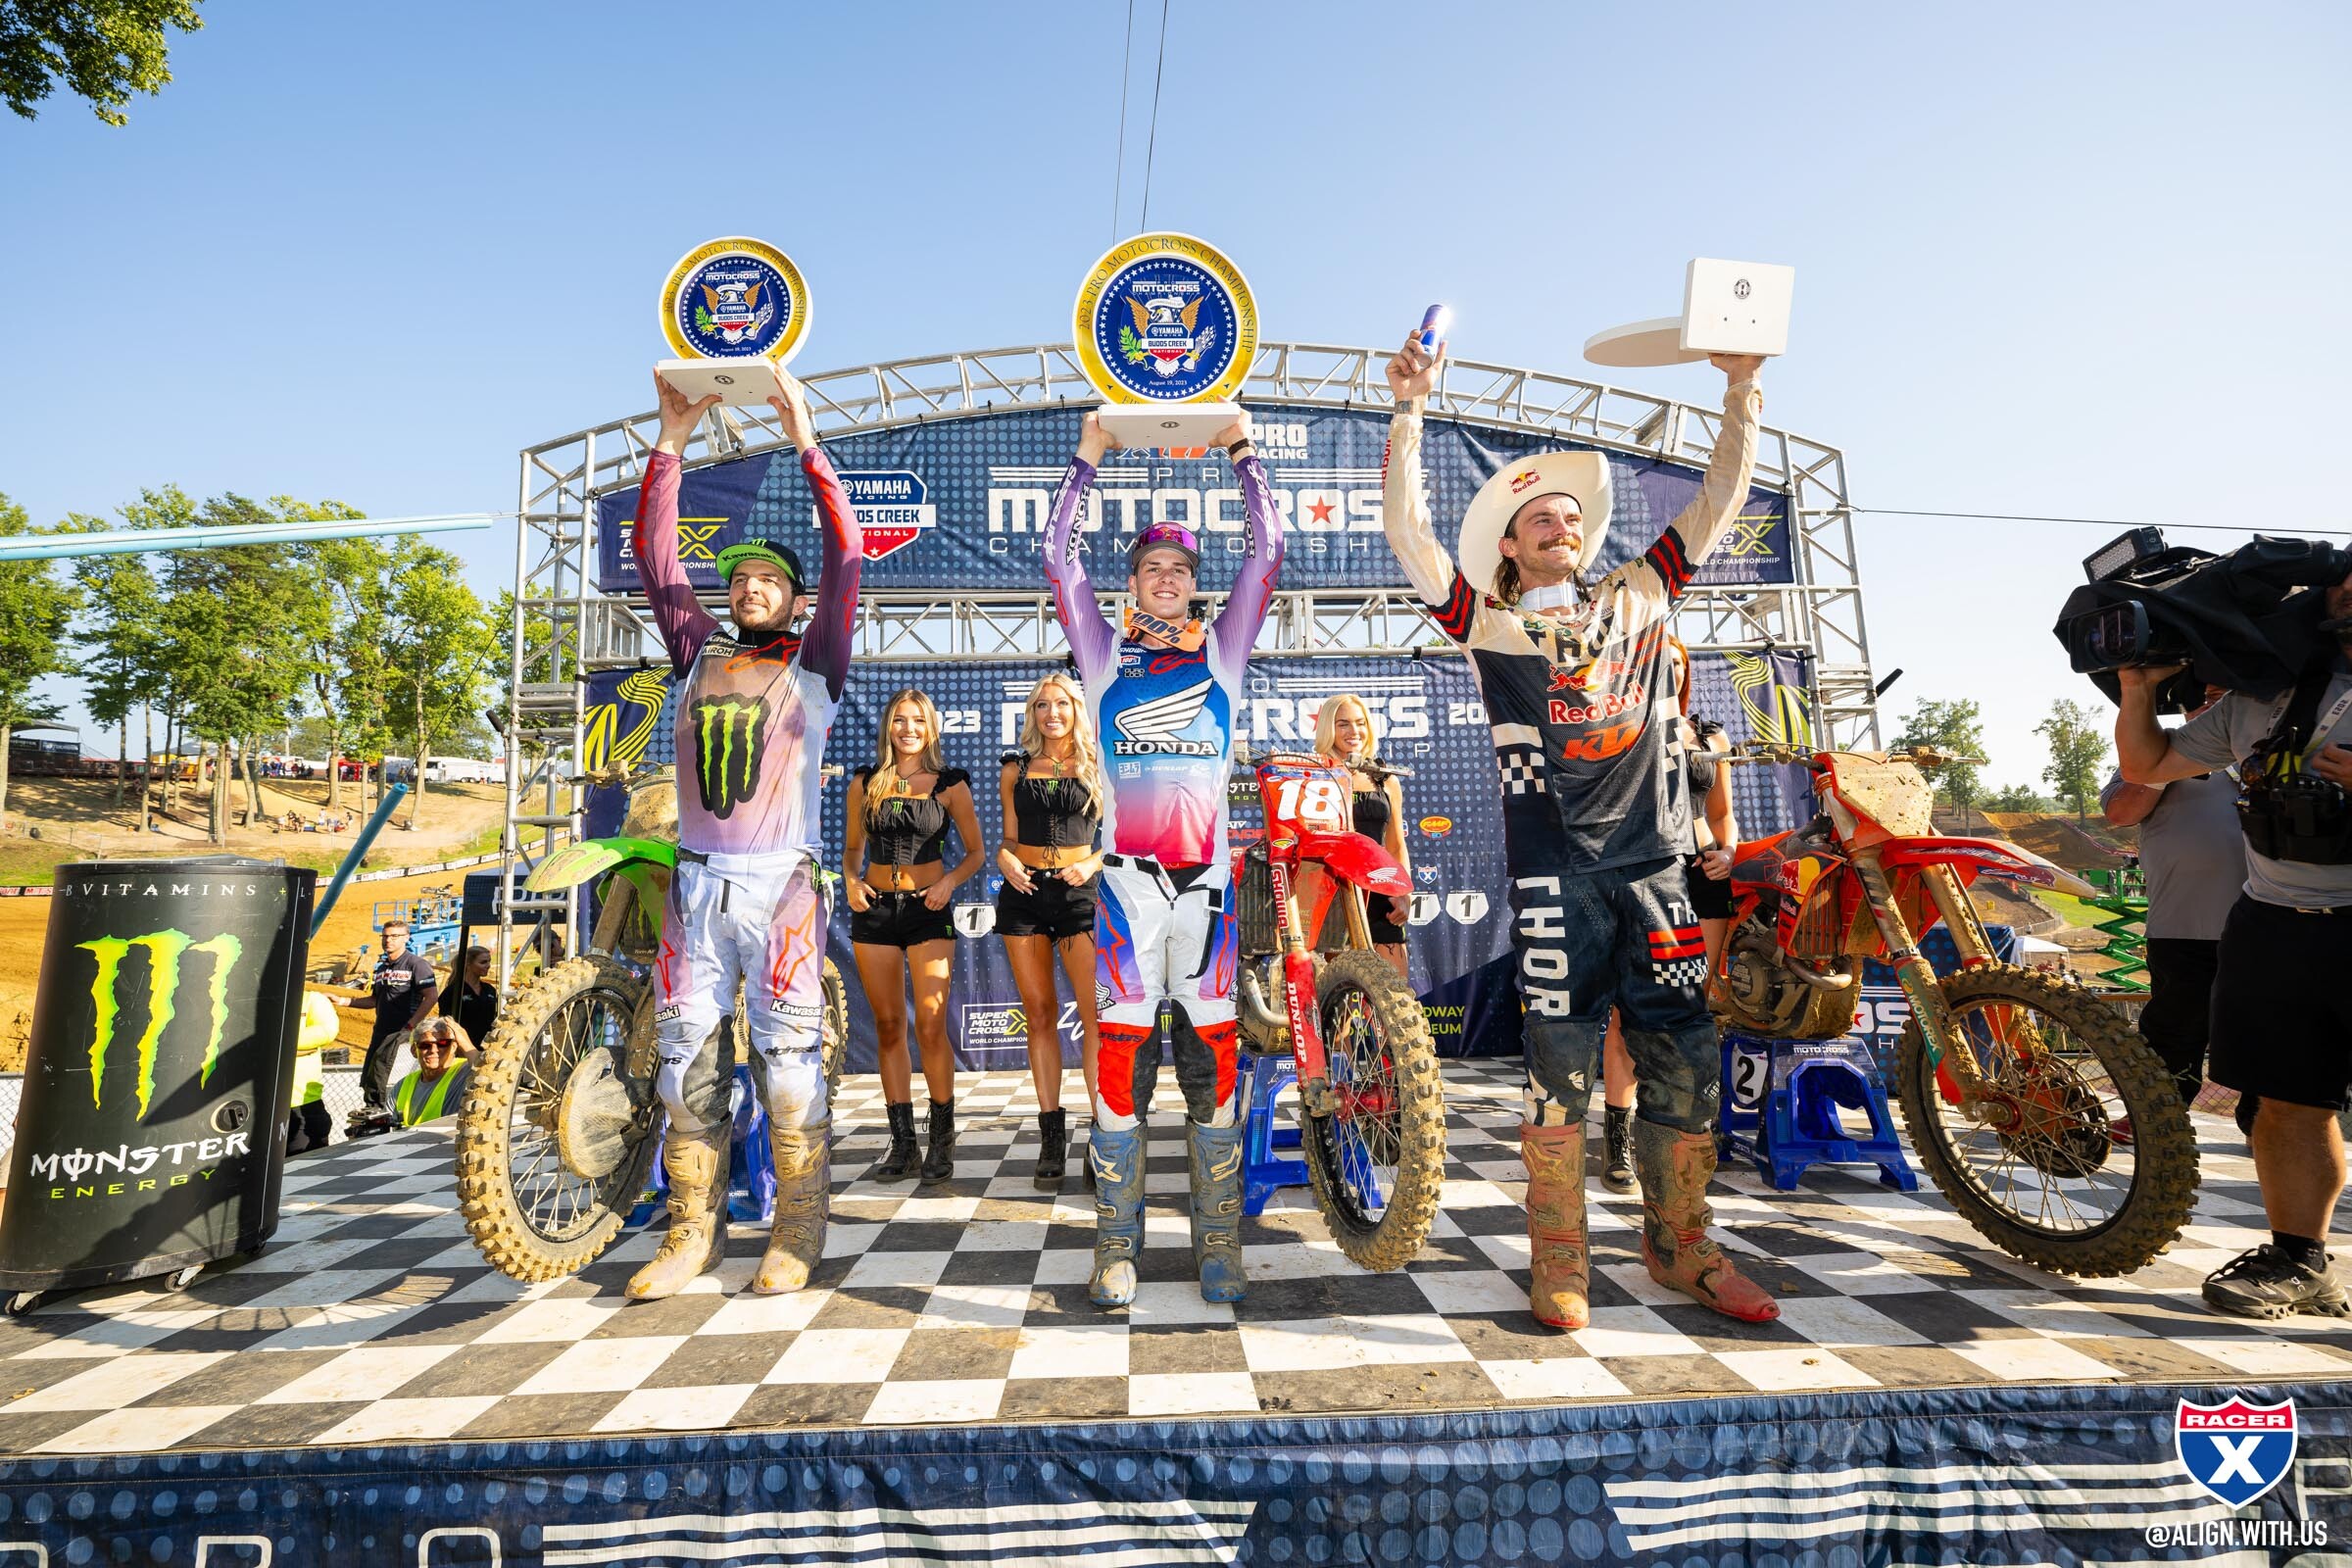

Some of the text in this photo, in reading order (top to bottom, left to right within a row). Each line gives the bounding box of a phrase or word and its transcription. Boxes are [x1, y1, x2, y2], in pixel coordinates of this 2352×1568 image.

[670, 265, 690, 288] PRO
[687, 241, 761, 269] MOTOCROSS
[762, 248, 806, 325] CHAMPIONSHIP
[706, 272, 760, 281] MOTOCROSS
[1079, 237, 1254, 354] 2023 PRO MOTOCROSS CHAMPIONSHIP
[1159, 326, 1183, 335] YAMAHA
[1250, 423, 1308, 447] PRO
[1258, 448, 1308, 460] ACING
[854, 480, 912, 495] YAMAHA
[876, 509, 920, 523] CREEK
[1065, 481, 1092, 565] HONDA
[721, 552, 776, 563] Kawasaki
[1716, 557, 1781, 565] CHAMPIONSHIP
[1132, 612, 1185, 645] 100%
[1548, 680, 1648, 724] Red Bull
[1114, 741, 1219, 757] HONDA
[1277, 779, 1345, 821] 18
[82, 883, 257, 897] VITAMINS
[656, 1006, 679, 1022] saki
[771, 1000, 821, 1017] Kawasa
[968, 1026, 1008, 1035] CROSS
[1287, 982, 1307, 1063] DUNLOP
[1908, 995, 1941, 1053] MOTOREX
[1736, 1055, 1756, 1099] 2
[30, 1132, 252, 1182] MONSTER
[50, 1168, 218, 1199] ENERGY
